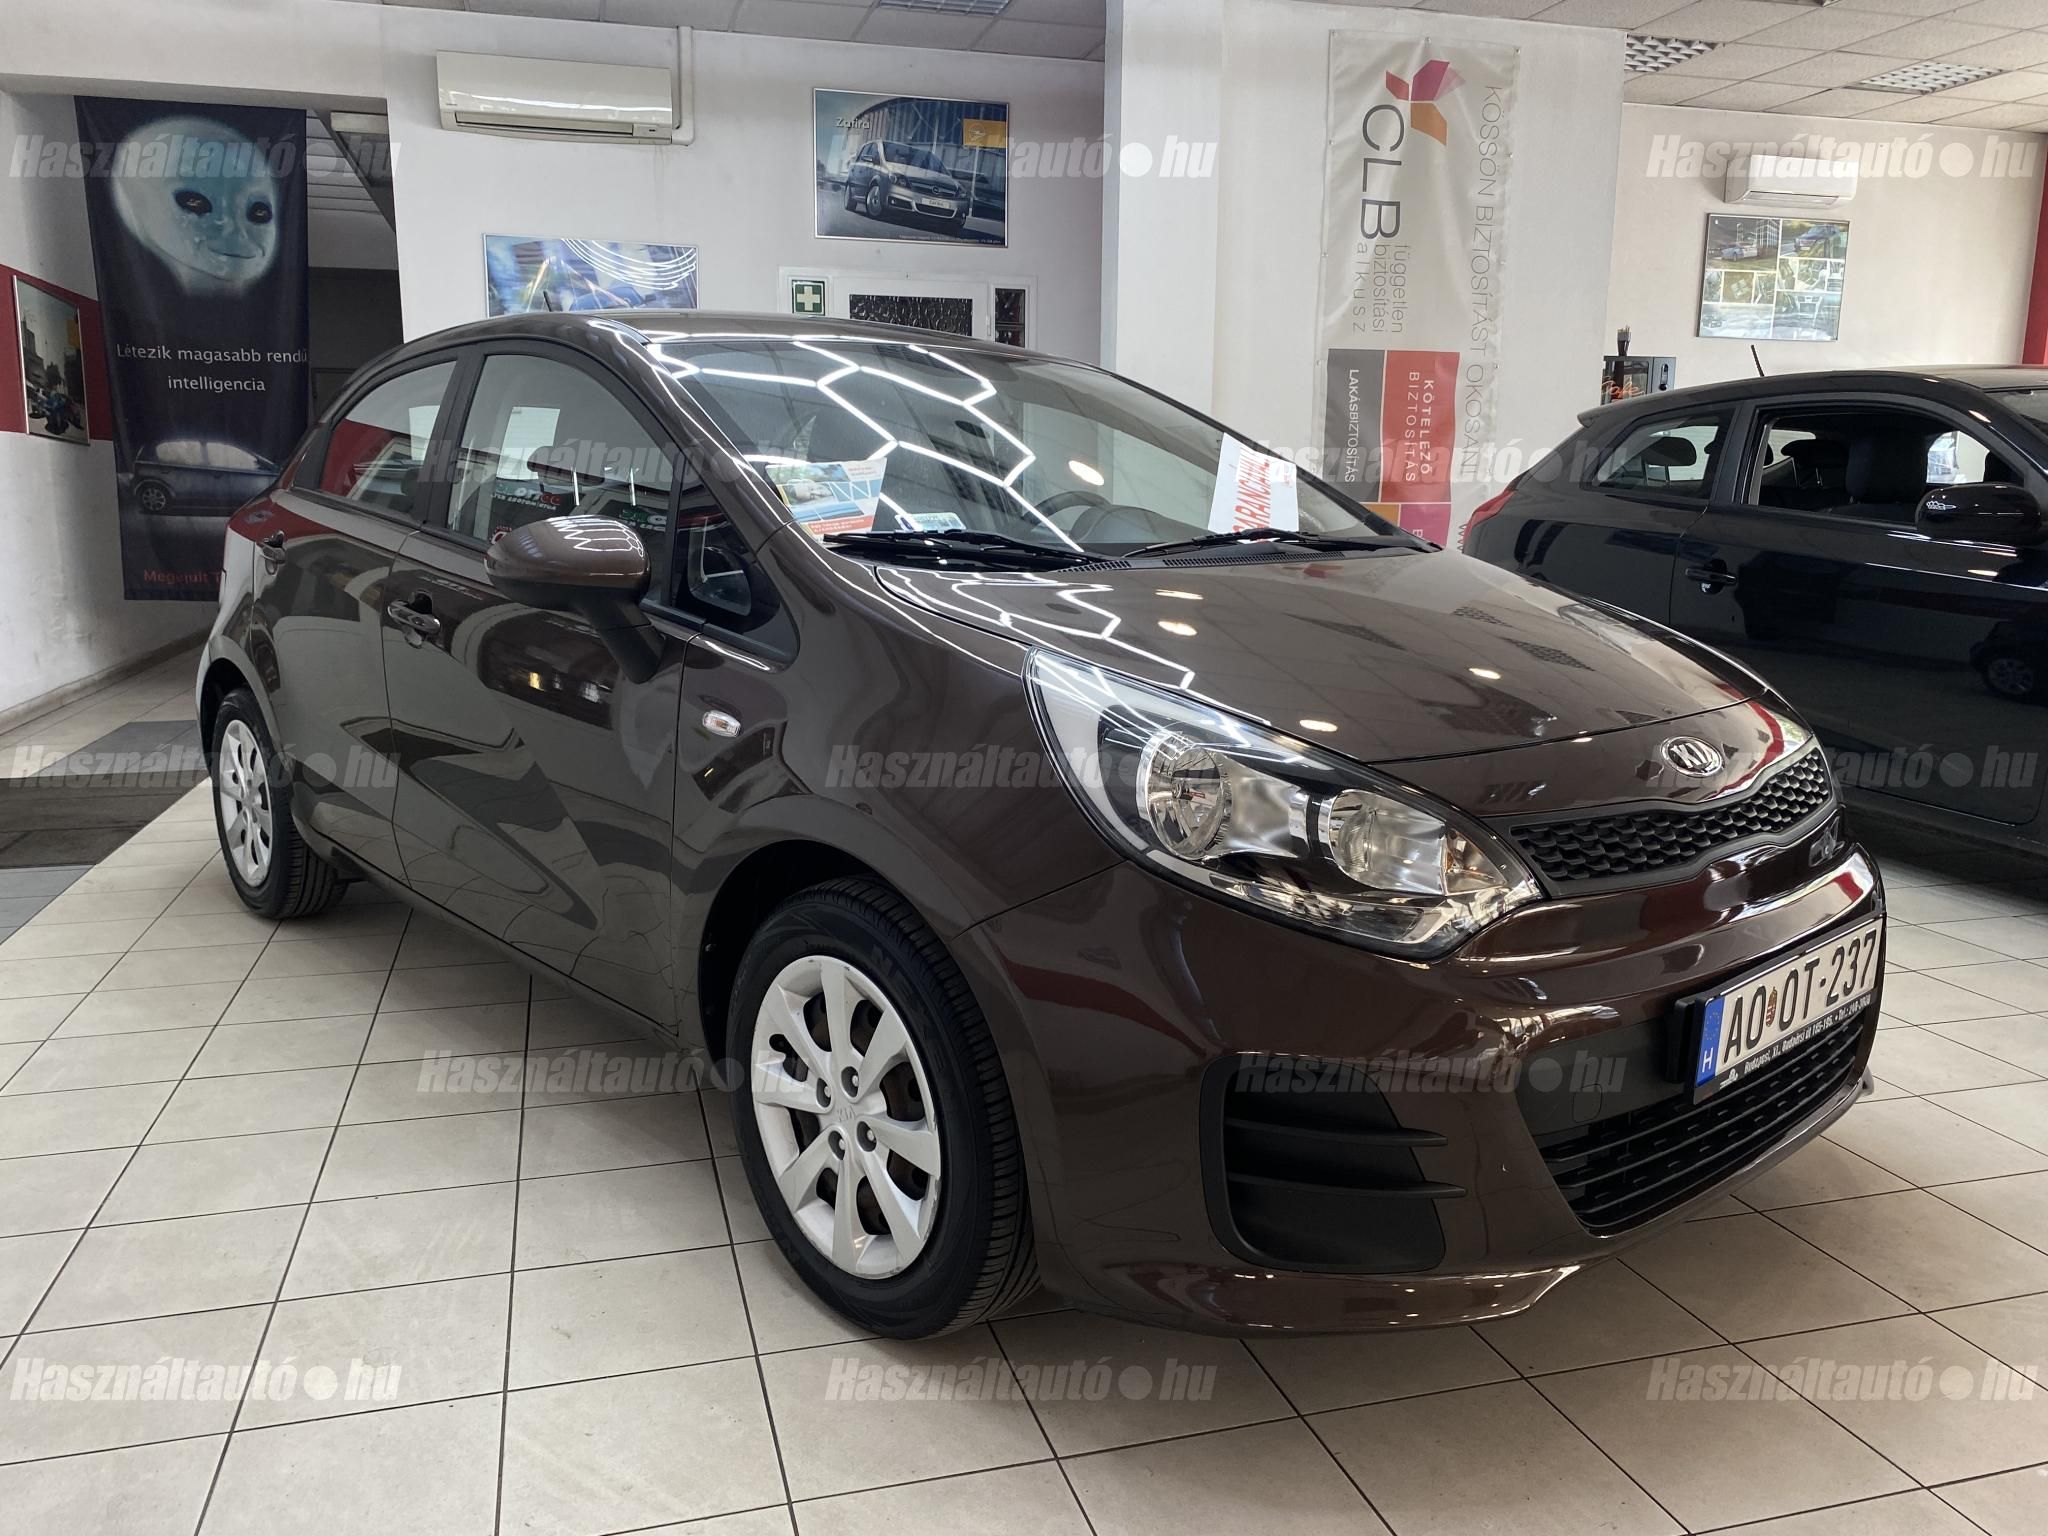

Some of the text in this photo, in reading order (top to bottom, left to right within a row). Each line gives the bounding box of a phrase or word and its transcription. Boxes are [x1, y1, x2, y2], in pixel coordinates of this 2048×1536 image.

[834, 116, 871, 129] Zafira
[1477, 85, 1503, 196] KÖSSÖN
[1360, 104, 1405, 241] CLB
[1373, 243, 1389, 334] biztosítási
[1389, 243, 1411, 335] független
[1470, 204, 1495, 357] BIZTOSÍTÁST
[116, 343, 172, 359] Létezik
[178, 348, 261, 364] magasabb
[168, 375, 266, 393] intelligencia
[1344, 368, 1362, 484] LAKÁSBIZTOSÍTÁS
[1402, 371, 1421, 483] BIZTOSÍTÁS
[1419, 379, 1438, 476] KÖTELEZŐ
[1702, 1047, 1714, 1074] H
